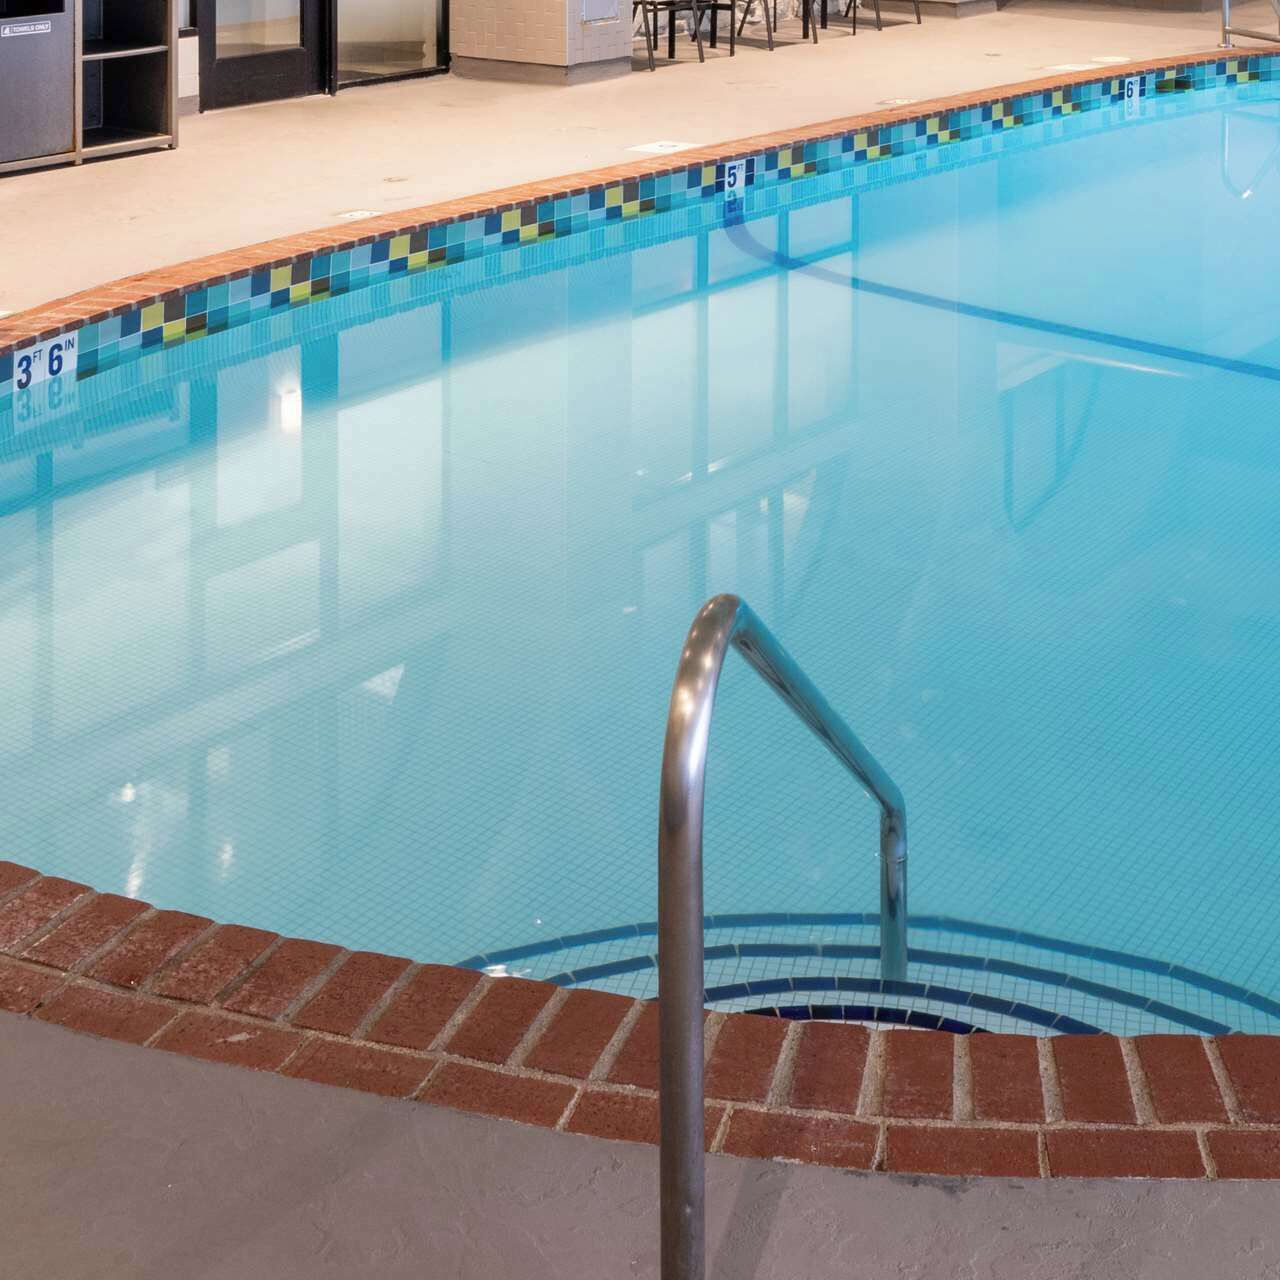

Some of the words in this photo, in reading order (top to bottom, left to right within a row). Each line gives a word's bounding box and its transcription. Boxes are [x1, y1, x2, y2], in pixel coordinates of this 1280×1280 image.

[35, 23, 49, 31] ONLY
[1127, 81, 1133, 98] 6
[727, 165, 737, 188] 5
[17, 355, 32, 389] 3
[32, 349, 43, 363] FT
[48, 343, 63, 376] 6
[65, 336, 75, 351] IN
